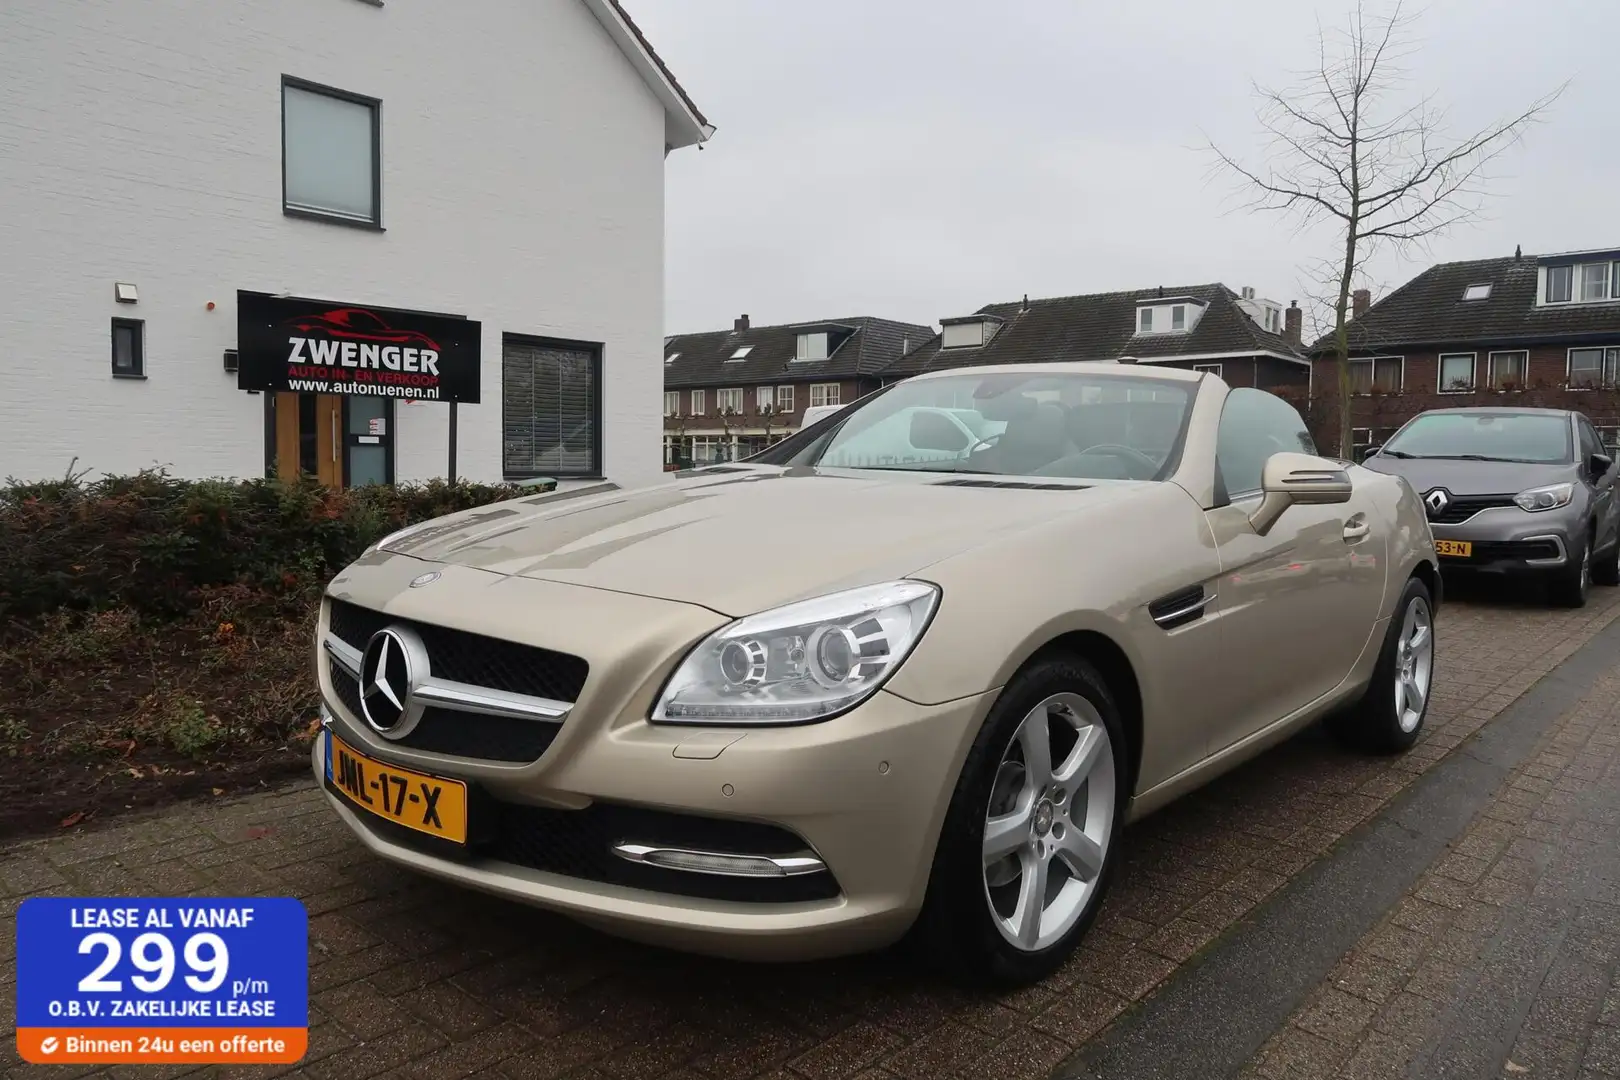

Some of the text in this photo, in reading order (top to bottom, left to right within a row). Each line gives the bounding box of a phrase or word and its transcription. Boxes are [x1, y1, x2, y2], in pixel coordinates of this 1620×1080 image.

[288, 336, 440, 377] ZWENGER
[288, 365, 328, 378] AUTO
[355, 370, 372, 382] EN
[376, 371, 439, 386] VERKOOP
[288, 379, 440, 399] www.autonuenen.nl
[337, 749, 443, 829] JNL-17-X
